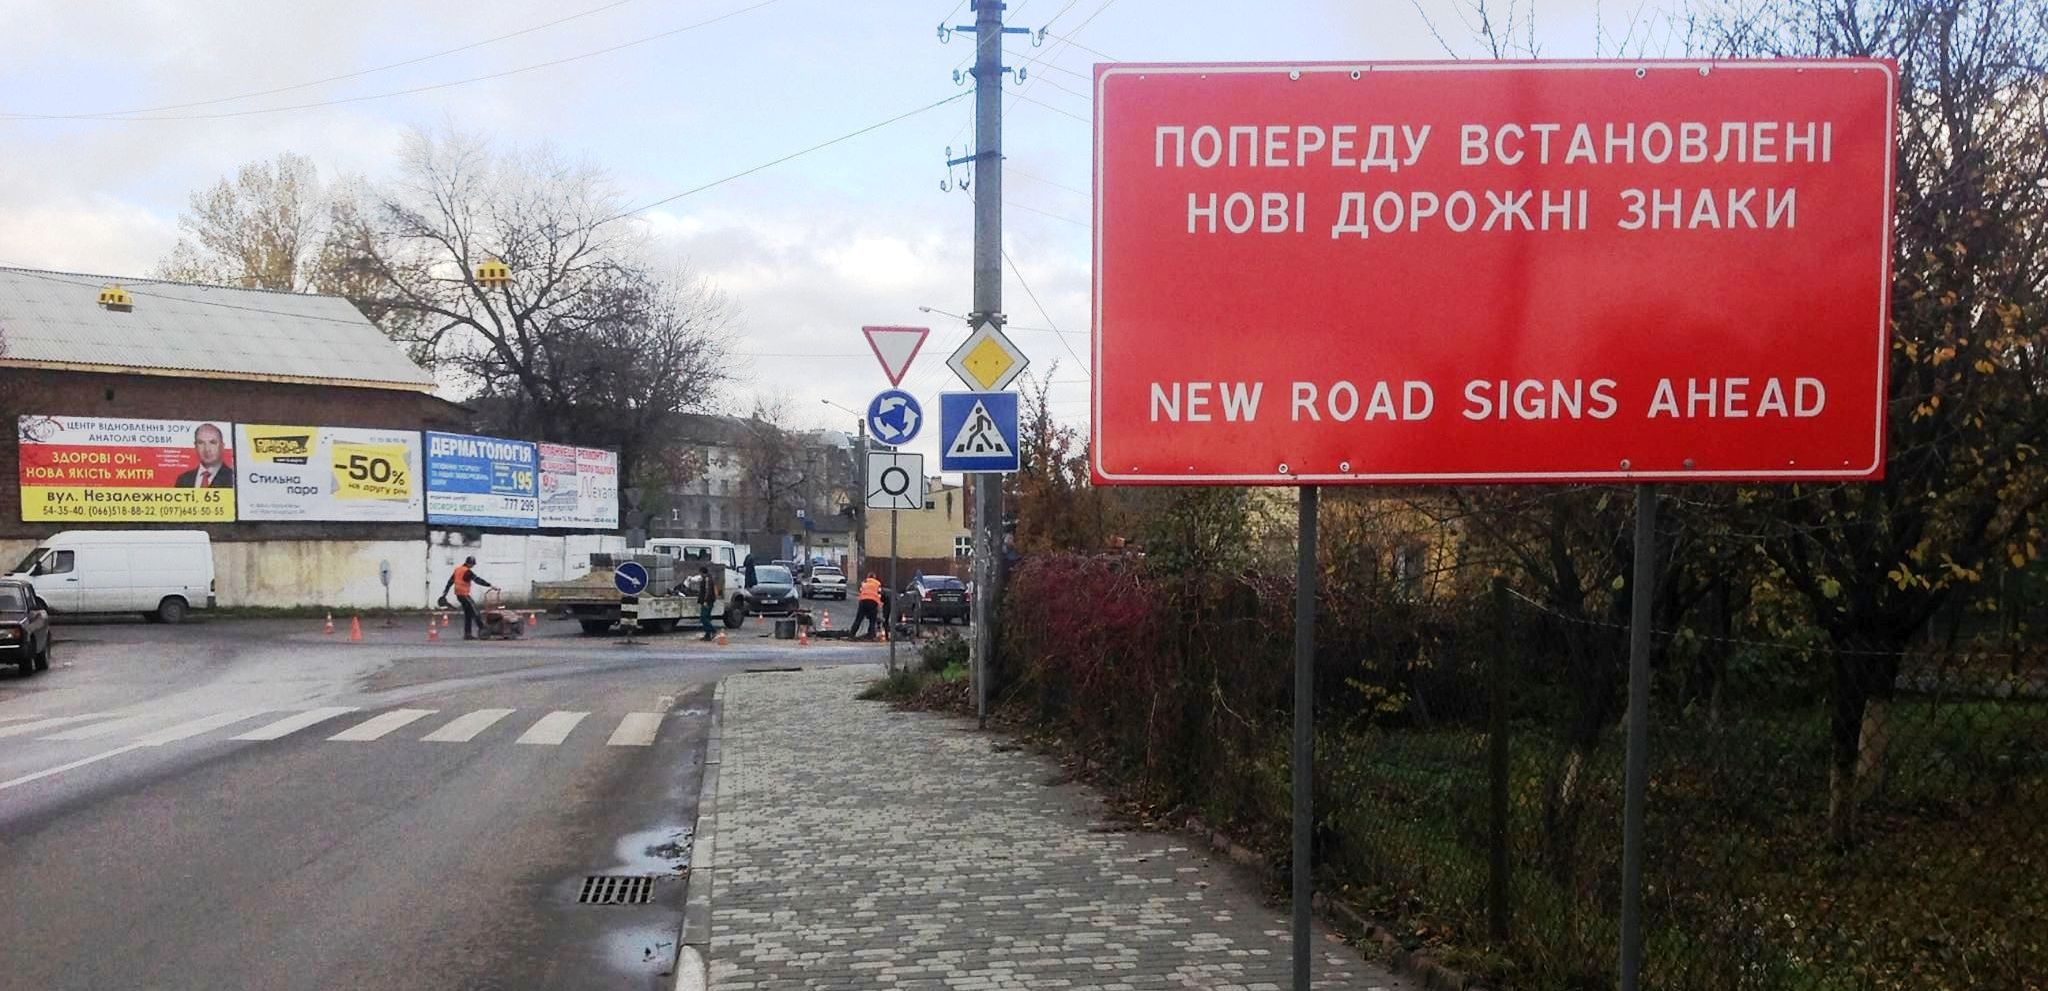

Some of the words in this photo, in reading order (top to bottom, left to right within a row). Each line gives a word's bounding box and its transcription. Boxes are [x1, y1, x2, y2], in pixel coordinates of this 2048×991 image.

[1154, 124, 1432, 174] ПОПЕРЕДУ
[1461, 122, 1832, 167] ВСТАНОВЛЕНІ
[1186, 192, 1305, 234] НОВІ
[1331, 189, 1589, 239] ДОРОЖНІ
[1617, 186, 1797, 230] ЗНАКИ
[1149, 382, 1264, 422] NEW
[1291, 381, 1435, 421] ROAD
[1462, 379, 1619, 420] SIGNS
[1647, 377, 1826, 418] AHEAD
[67, 421, 96, 430] ЦЕНТР
[99, 422, 164, 432] ВІДНОВЛЕННЯ
[167, 424, 191, 433] ЗОРУ
[89, 434, 137, 442] АНАТОЛІЯ
[431, 437, 532, 462] ДЕРМАТОЛОГІЯ
[52, 452, 111, 464] ЗДОРОВІ
[114, 453, 141, 465] ОЧІ-
[26, 467, 64, 478] НОВА
[69, 468, 111, 479] ЯКІСТЬ
[115, 469, 154, 480] ЖИТТЯ
[249, 473, 301, 484] Стильна
[512, 471, 532, 491] 195
[47, 492, 78, 503] вул.
[204, 491, 220, 502] 65
[287, 486, 318, 495] пара
